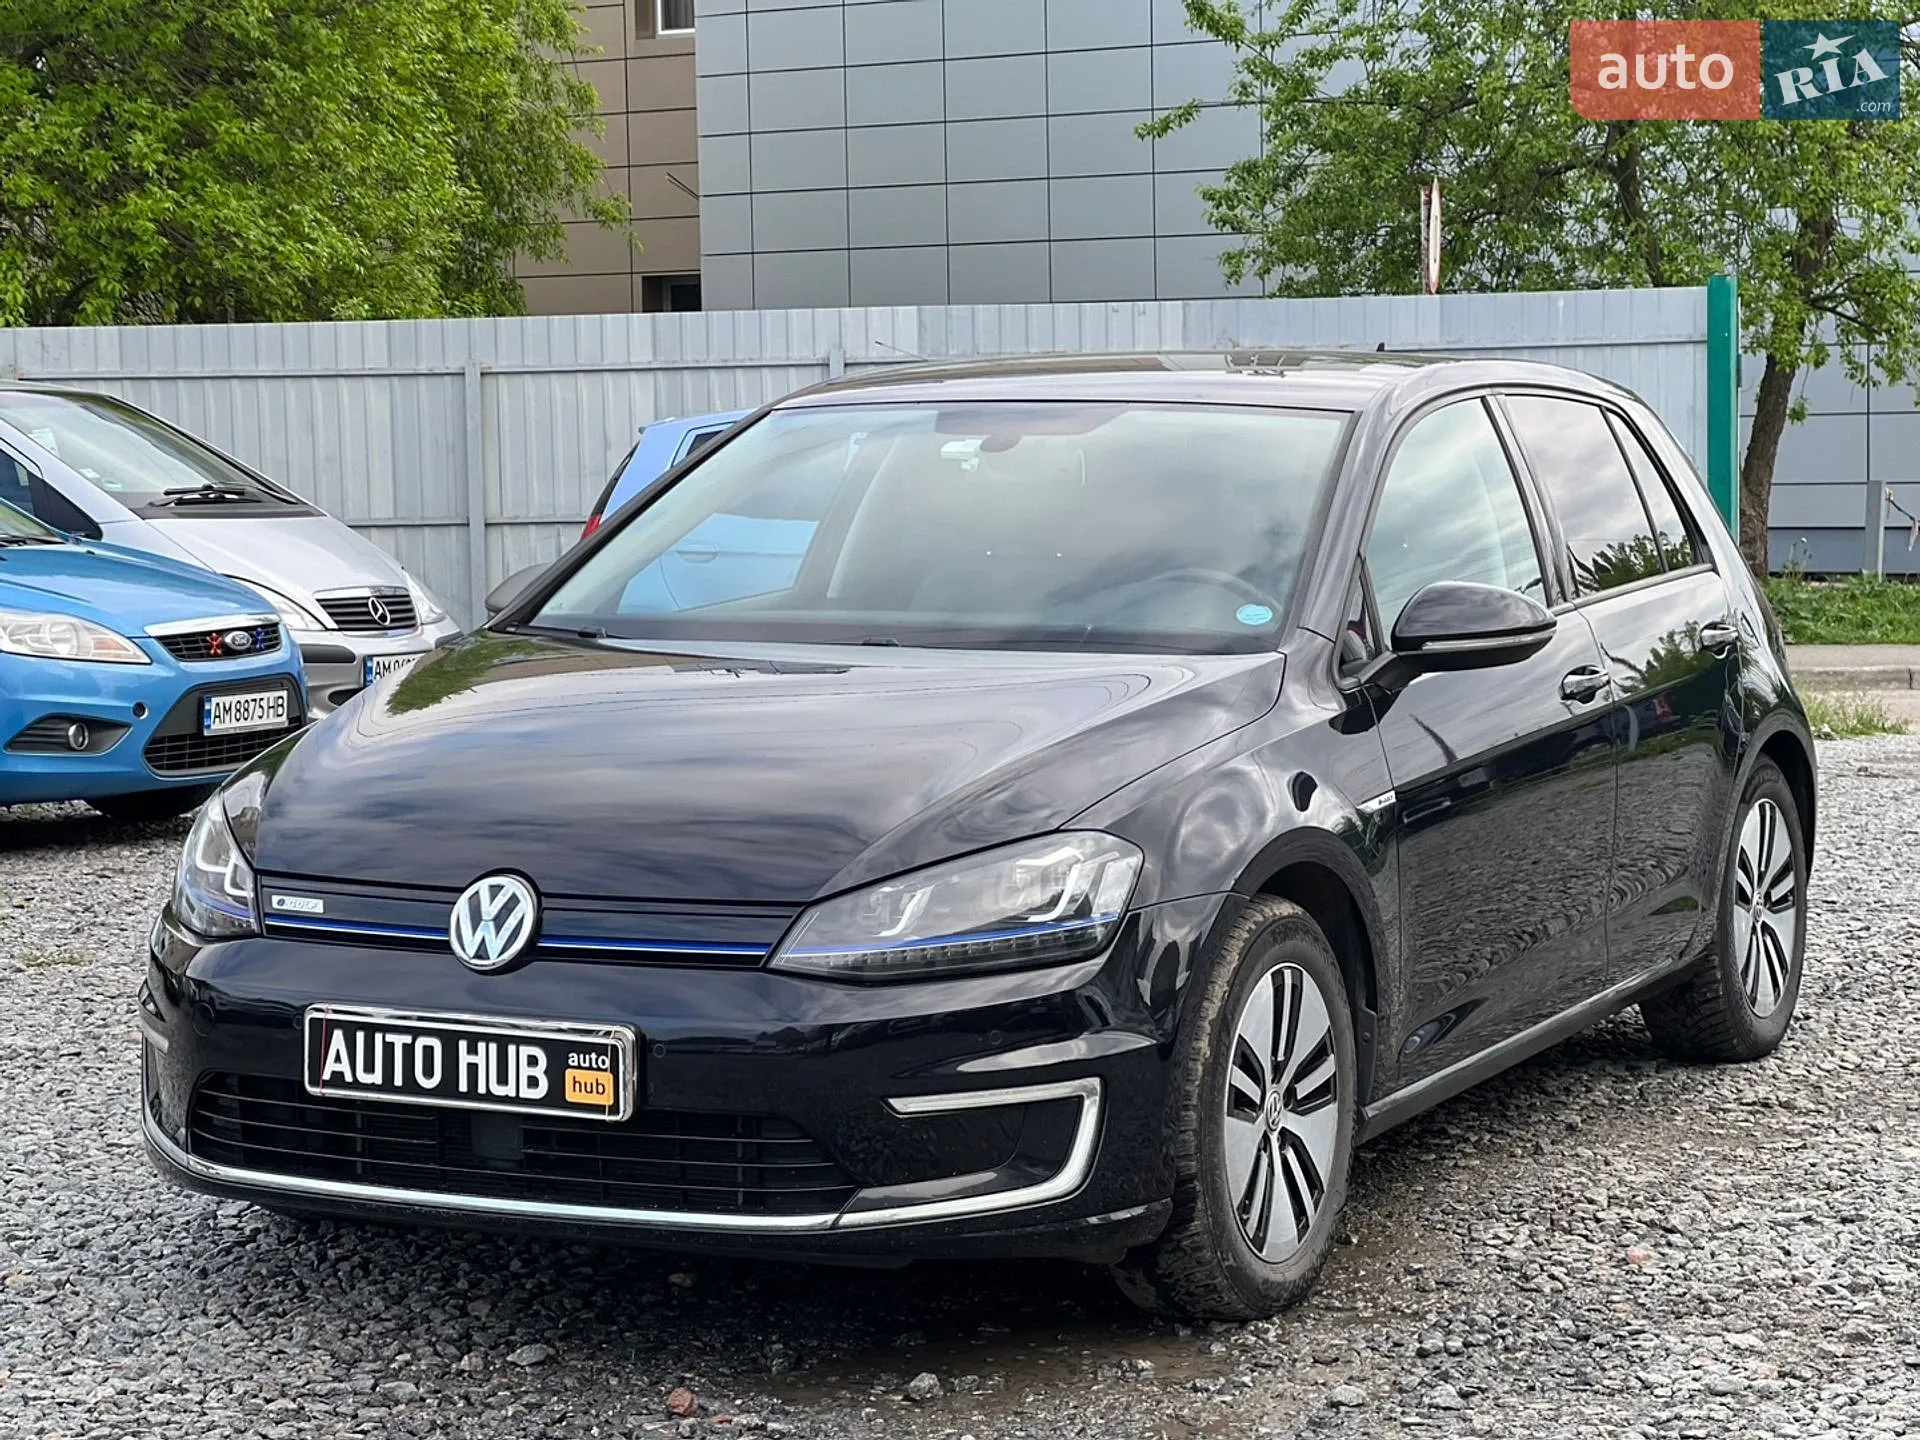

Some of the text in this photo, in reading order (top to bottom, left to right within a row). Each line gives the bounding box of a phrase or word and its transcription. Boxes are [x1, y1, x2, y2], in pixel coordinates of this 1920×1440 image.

[322, 1028, 549, 1101] AUTO HUB
[567, 1051, 609, 1070] auto
[572, 1074, 606, 1096] hub
